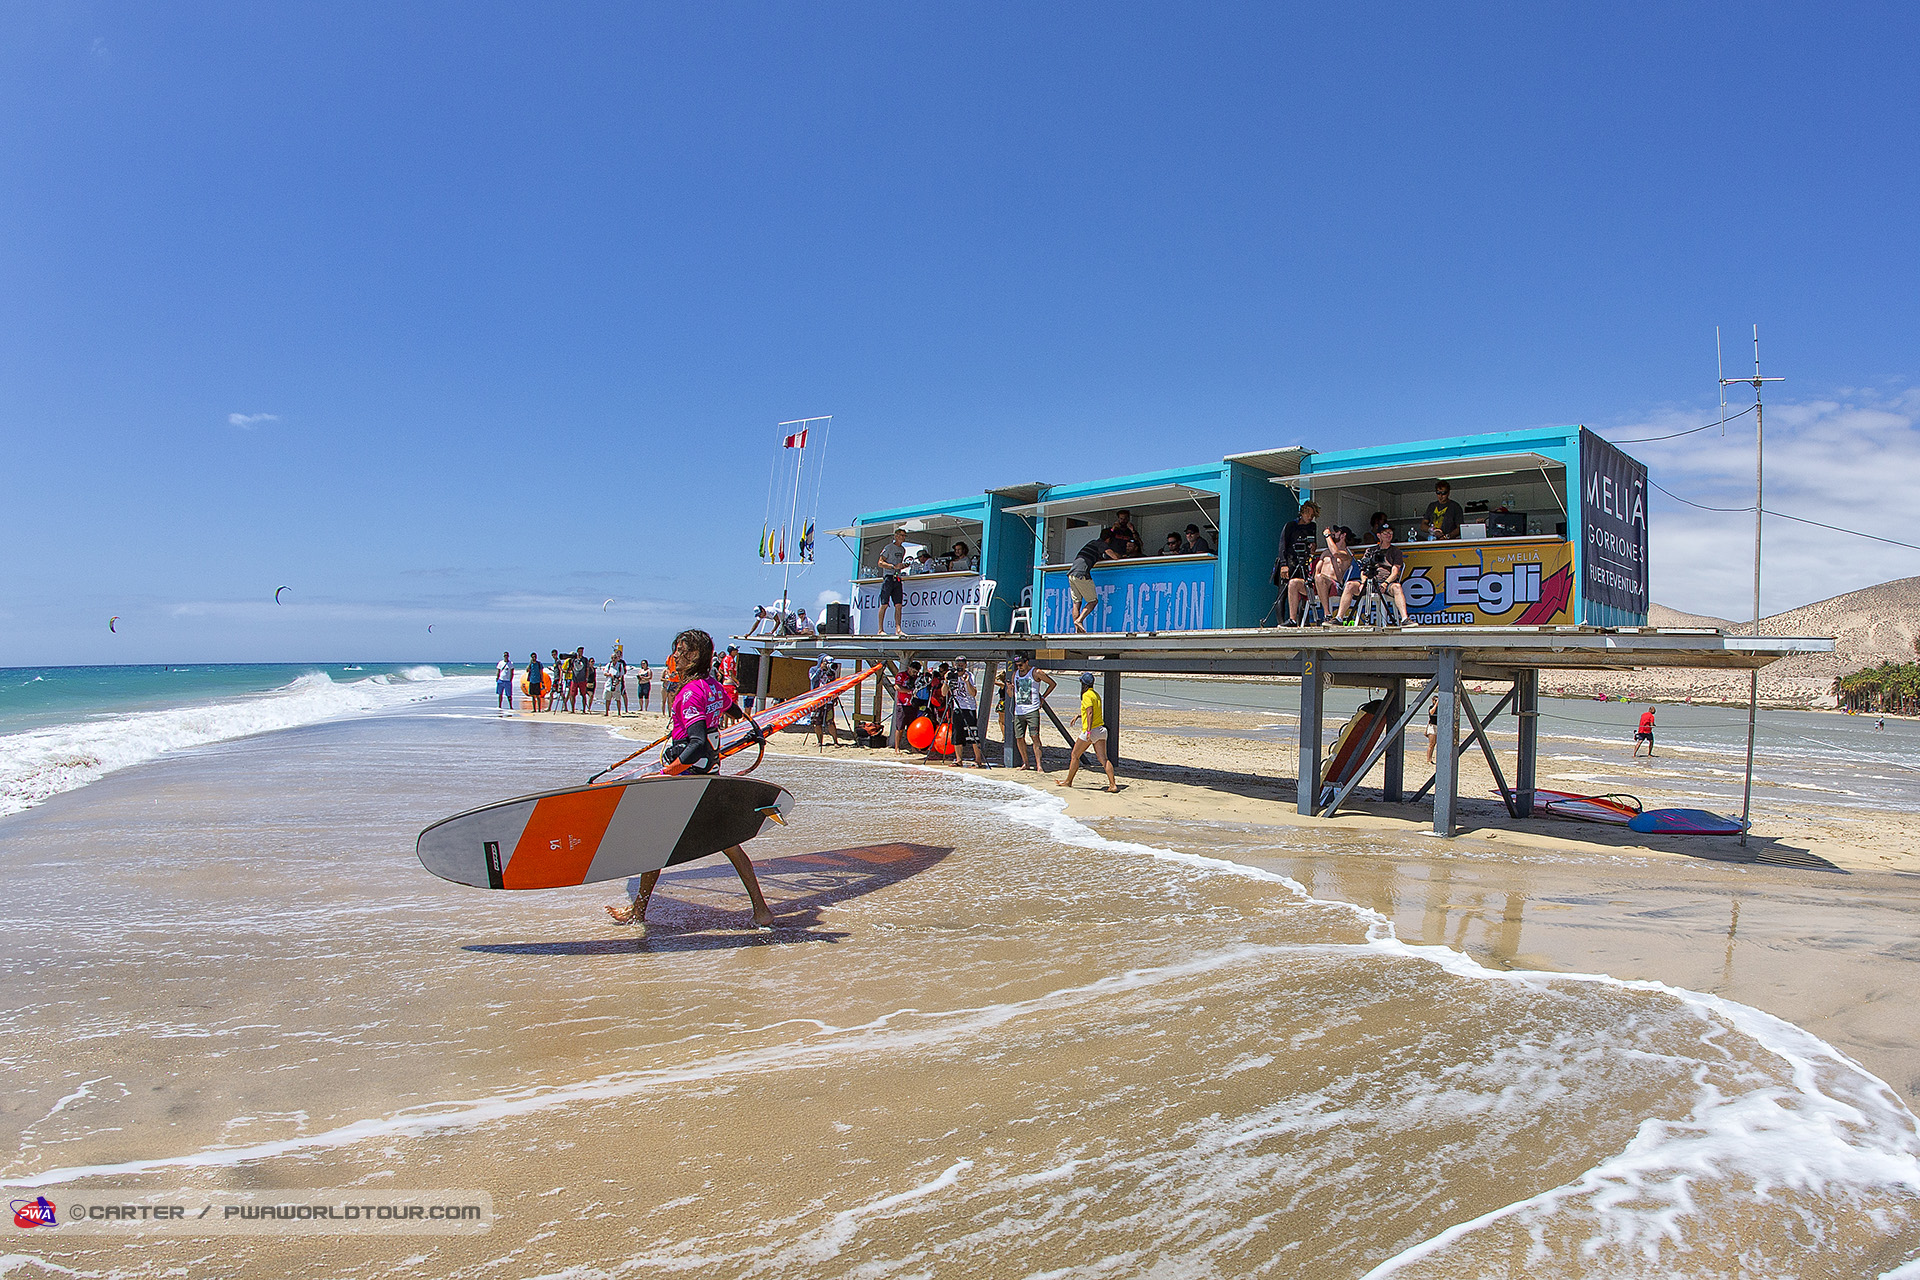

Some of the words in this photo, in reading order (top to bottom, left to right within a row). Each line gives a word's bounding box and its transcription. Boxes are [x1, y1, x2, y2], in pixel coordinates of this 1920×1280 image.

[1588, 524, 1644, 563] GORRIONES
[1445, 563, 1542, 614] Egli
[1589, 564, 1645, 596] FUERTEVENTURA
[887, 619, 936, 629] FUTEVENTURA
[1121, 581, 1206, 633] ACTION
[1304, 661, 1313, 675] 2
